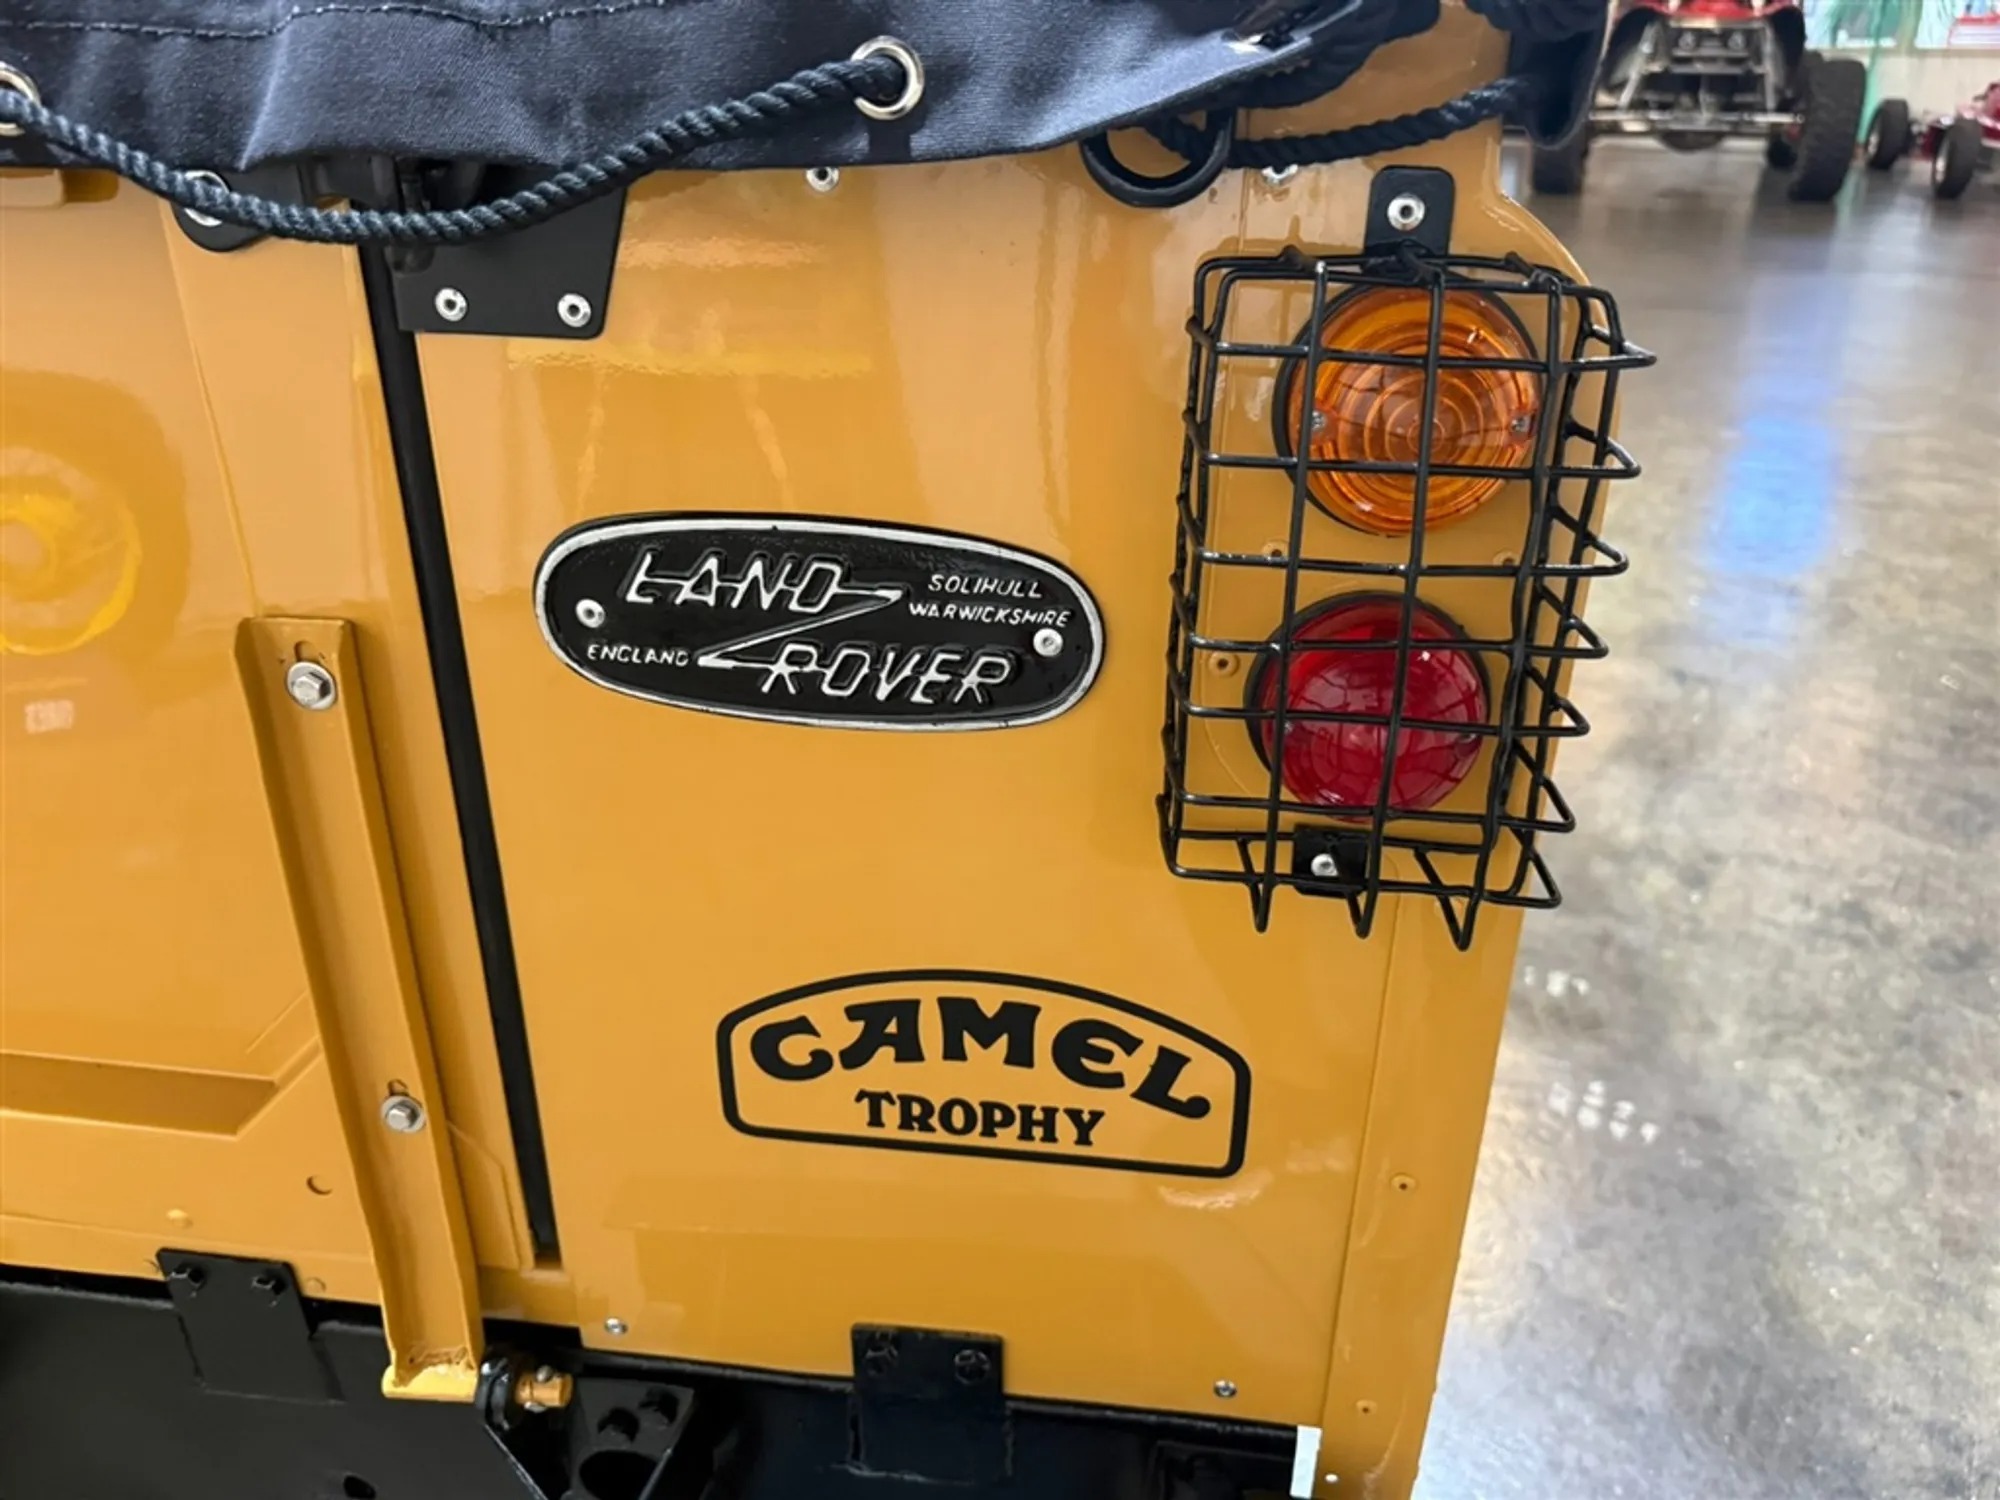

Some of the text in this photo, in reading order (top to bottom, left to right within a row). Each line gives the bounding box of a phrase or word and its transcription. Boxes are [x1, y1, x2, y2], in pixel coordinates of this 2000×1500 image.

[626, 552, 842, 613] LAND
[928, 574, 1043, 599] SOLIHULL
[908, 602, 1072, 628] WARWICKSHIRE
[586, 644, 690, 668] ENGLAND
[760, 643, 1011, 704] ROVER
[750, 996, 1212, 1120] CAMEL
[854, 1089, 1105, 1147] TROPHY
